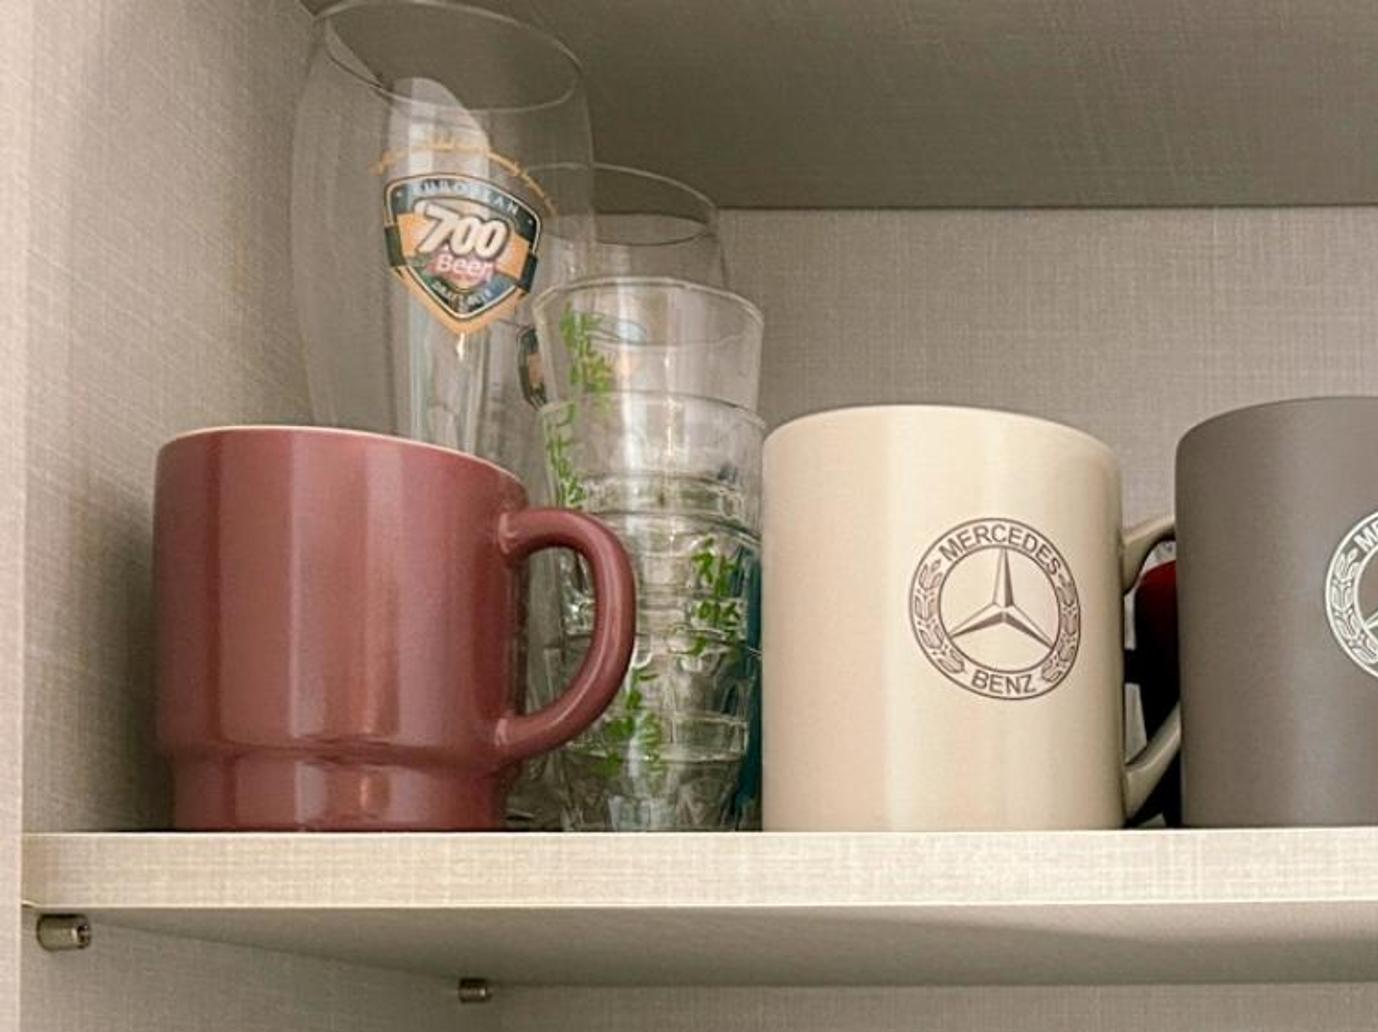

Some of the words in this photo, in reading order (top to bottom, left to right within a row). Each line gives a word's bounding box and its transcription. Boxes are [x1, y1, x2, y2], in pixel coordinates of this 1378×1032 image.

[413, 200, 510, 259] 700
[437, 254, 494, 283] Beer
[937, 524, 1061, 576] MERCEDES
[971, 669, 1037, 695] BENZ
